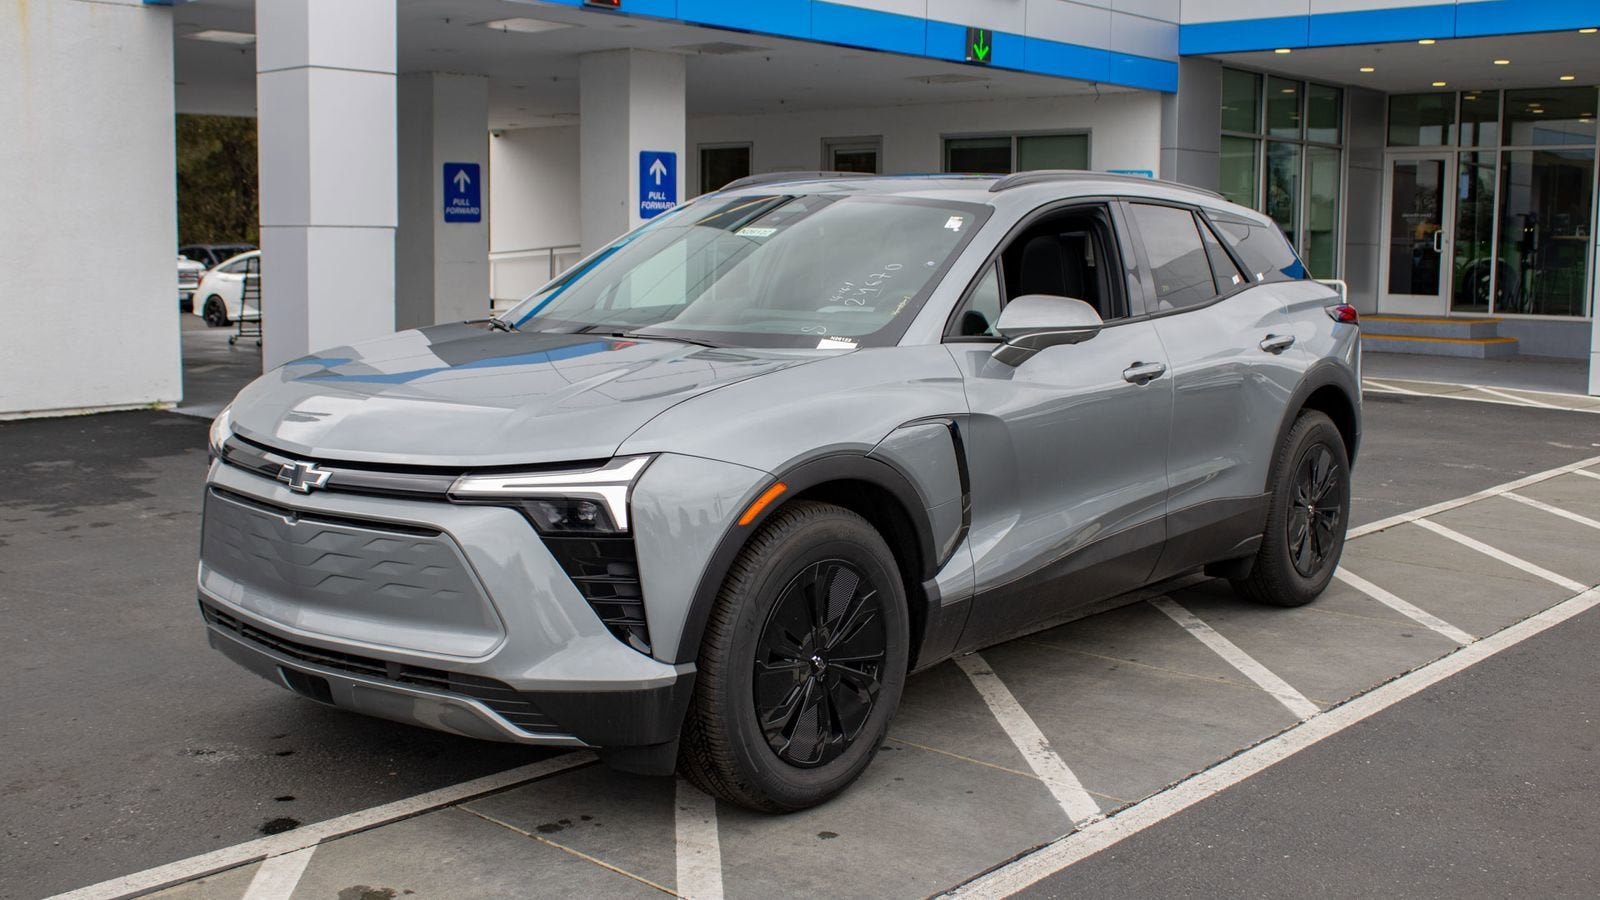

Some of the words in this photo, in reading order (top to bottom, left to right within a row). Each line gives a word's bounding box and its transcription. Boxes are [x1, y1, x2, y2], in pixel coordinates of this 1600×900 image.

[648, 191, 667, 200] PULL
[452, 198, 471, 206] PULL
[641, 201, 676, 210] FORWARD
[446, 207, 480, 215] FORWARD
